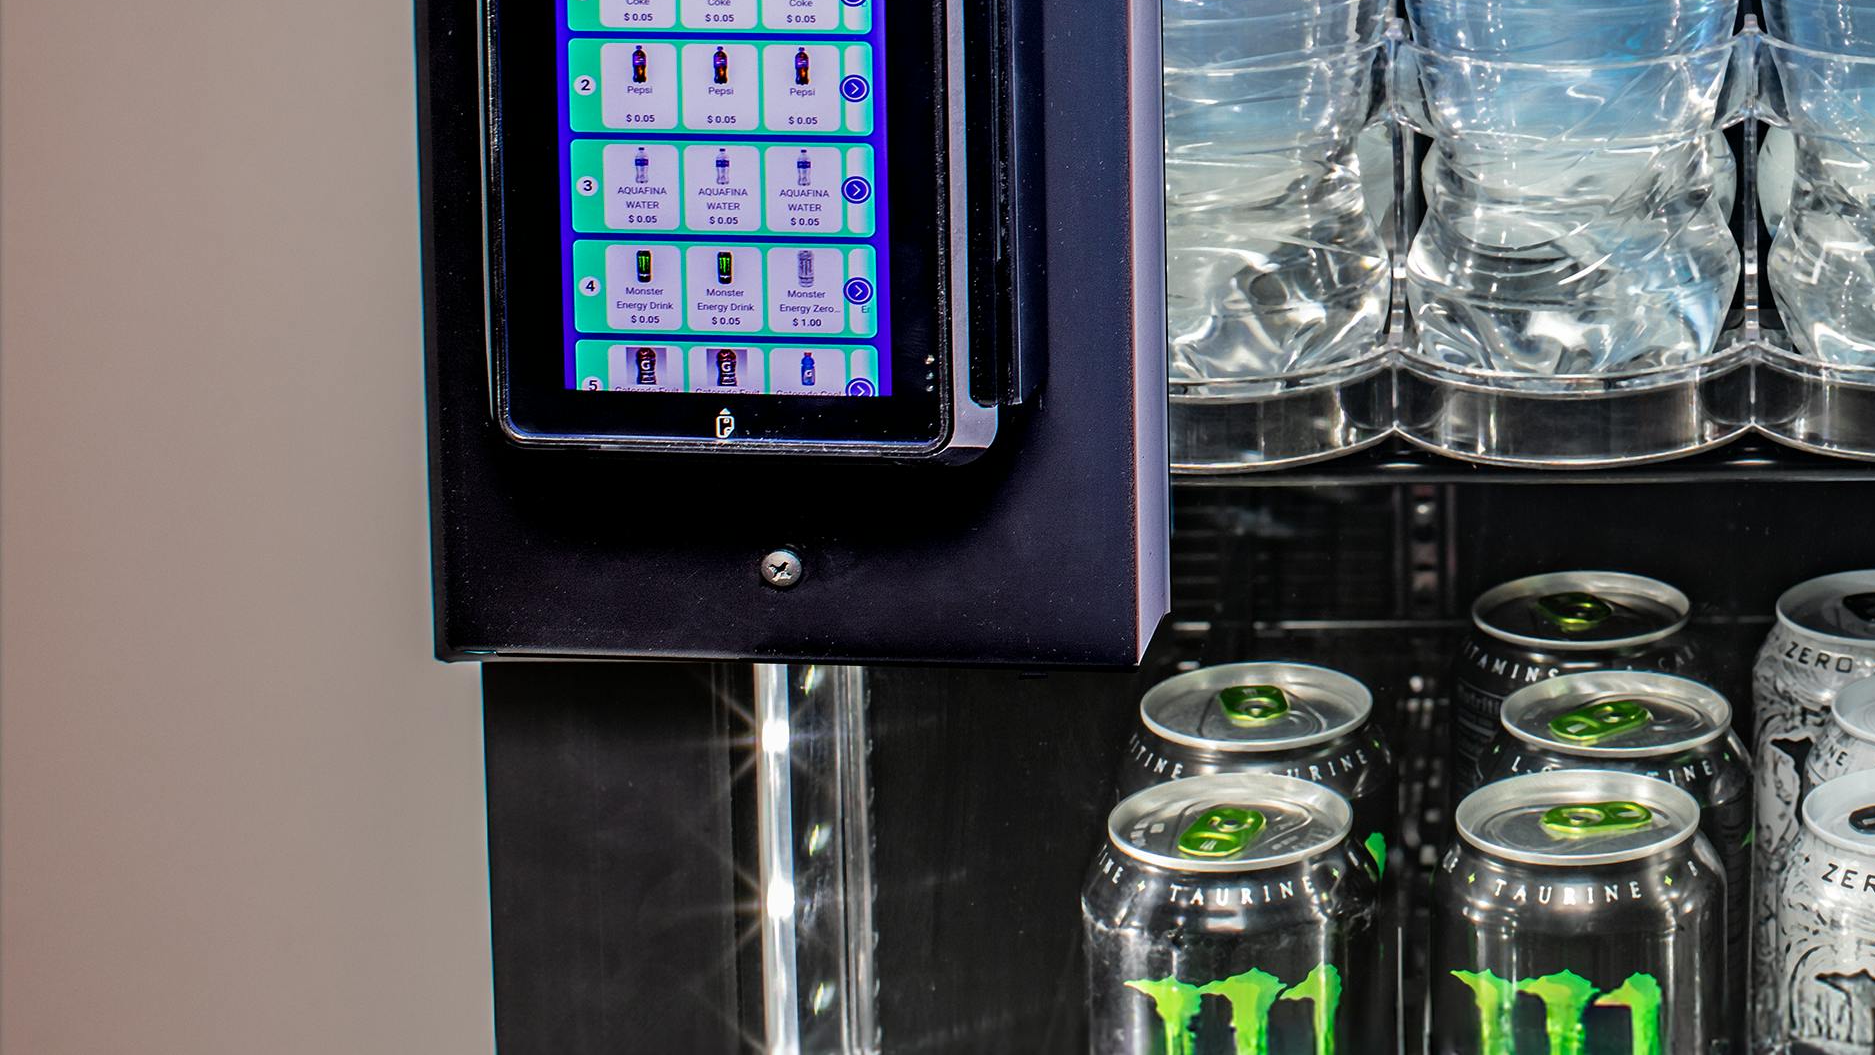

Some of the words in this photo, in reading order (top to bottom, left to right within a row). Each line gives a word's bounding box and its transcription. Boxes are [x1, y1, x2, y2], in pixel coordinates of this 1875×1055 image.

[624, 12, 630, 23] $
[632, 12, 653, 22] 0.05
[705, 13, 711, 24] $
[714, 13, 734, 23] 0.05
[786, 14, 792, 24] $
[795, 14, 816, 24] 0.05
[581, 79, 590, 91] 2
[627, 85, 653, 96] Pepsi
[708, 86, 734, 97] Pepsi
[789, 87, 816, 98] Pepsi
[626, 113, 632, 123] $
[634, 114, 655, 123] 0.05
[707, 114, 713, 125] $
[715, 115, 736, 124] 0.05
[788, 115, 795, 126] $
[797, 116, 818, 125] 0.05
[583, 180, 592, 191] 3
[617, 186, 667, 196] AQUAFINA
[698, 187, 748, 197] AQUAFINA
[779, 189, 829, 199] AQUAFINA
[626, 200, 660, 209] WATER
[706, 201, 740, 211] WATER
[788, 203, 822, 212] WATER
[628, 214, 634, 224] $
[636, 215, 658, 224] 0.05
[709, 215, 715, 226] $
[718, 216, 739, 225] 0.05
[790, 216, 797, 227] $
[799, 217, 820, 226] 0.05
[586, 280, 595, 292] 4
[625, 287, 664, 296] Monster
[706, 288, 744, 298] Monster
[787, 289, 826, 299] Monster
[616, 301, 648, 312] Energy
[650, 301, 674, 310] Drink
[697, 302, 728, 313] Energy
[731, 302, 755, 311] Drink
[779, 304, 811, 315] Energy
[631, 314, 637, 325] $
[639, 315, 660, 324] 0.05
[711, 316, 718, 326] $
[720, 316, 741, 326] 0.05
[793, 318, 799, 328] $
[801, 318, 822, 328] 1.00
[1784, 640, 1853, 674] ZERO
[1169, 875, 1314, 906] TAURINE
[1494, 878, 1643, 905] TAURINE
